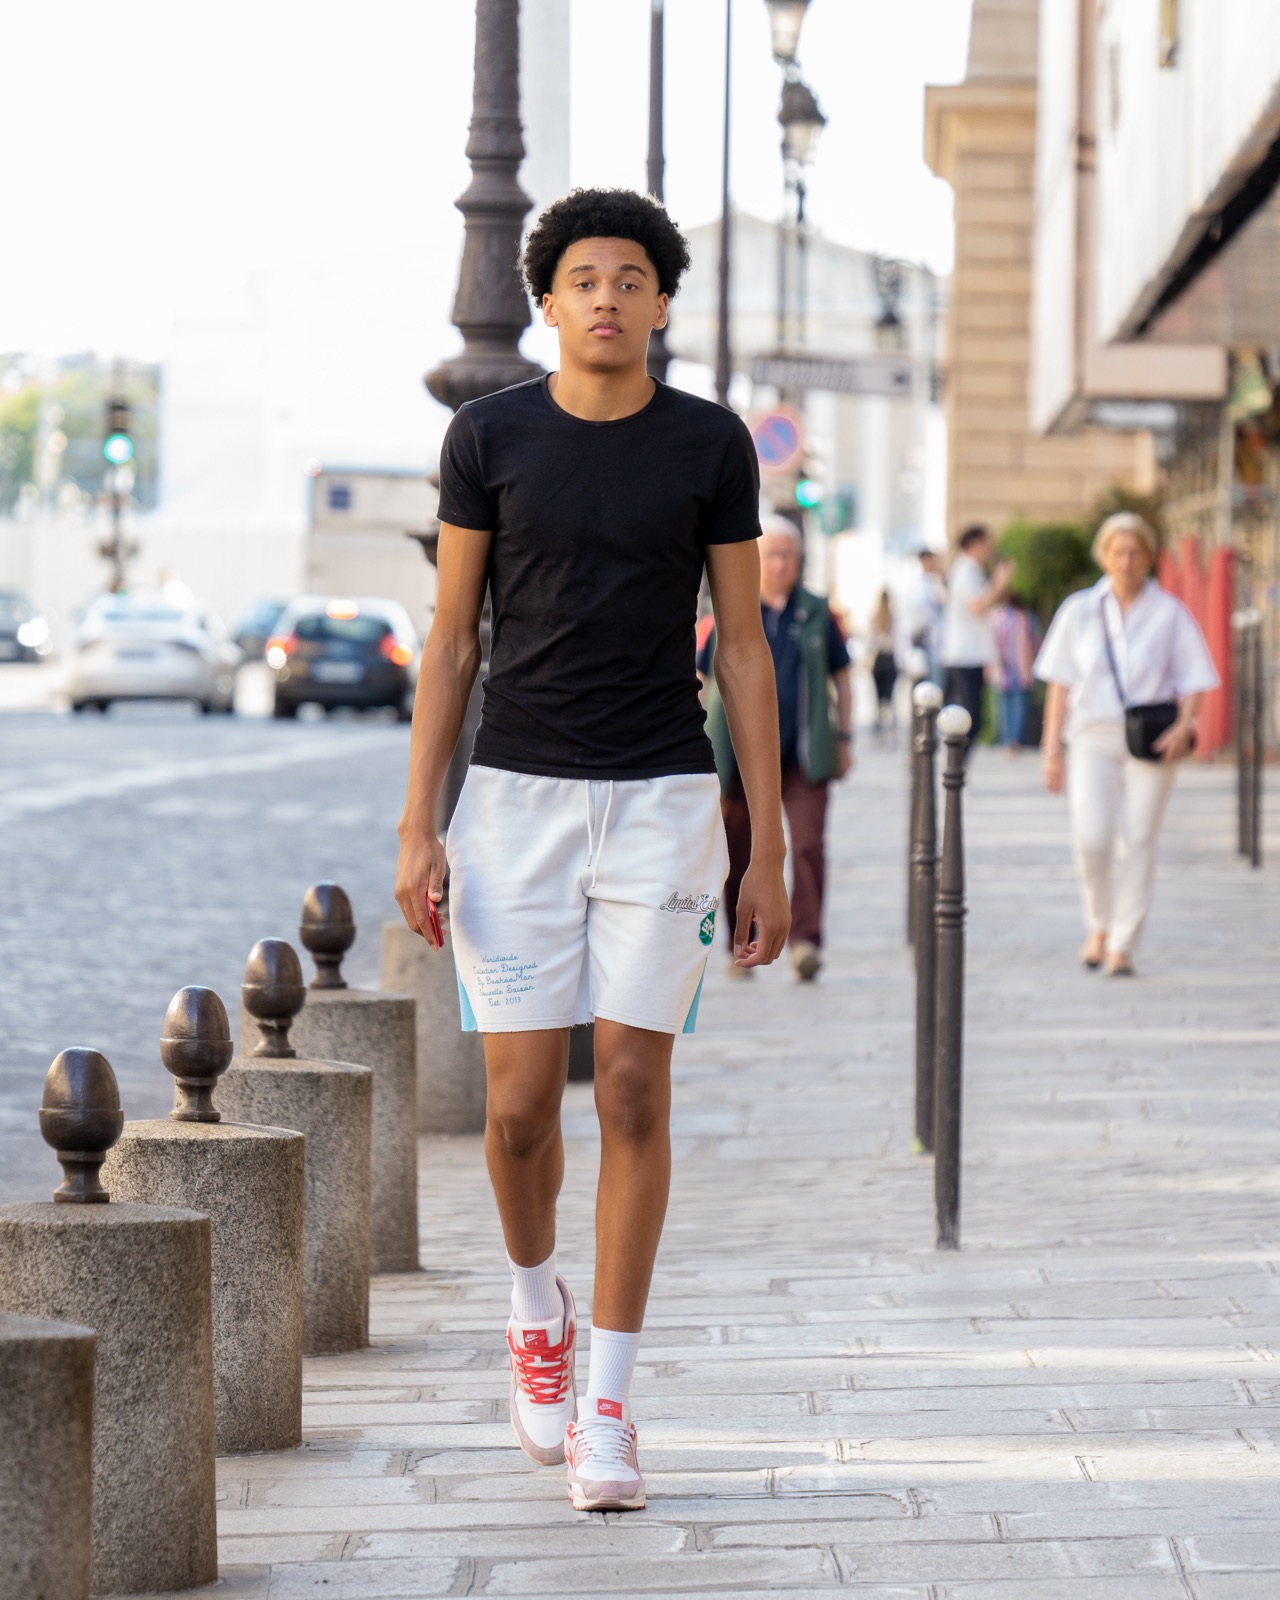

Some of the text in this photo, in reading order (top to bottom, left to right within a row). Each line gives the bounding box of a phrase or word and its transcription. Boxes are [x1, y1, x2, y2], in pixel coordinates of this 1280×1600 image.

[659, 891, 700, 912] Limited
[480, 954, 519, 963] Worldwide
[500, 961, 538, 975] Designed
[506, 984, 535, 993] Saison
[505, 997, 522, 1005] 2013
